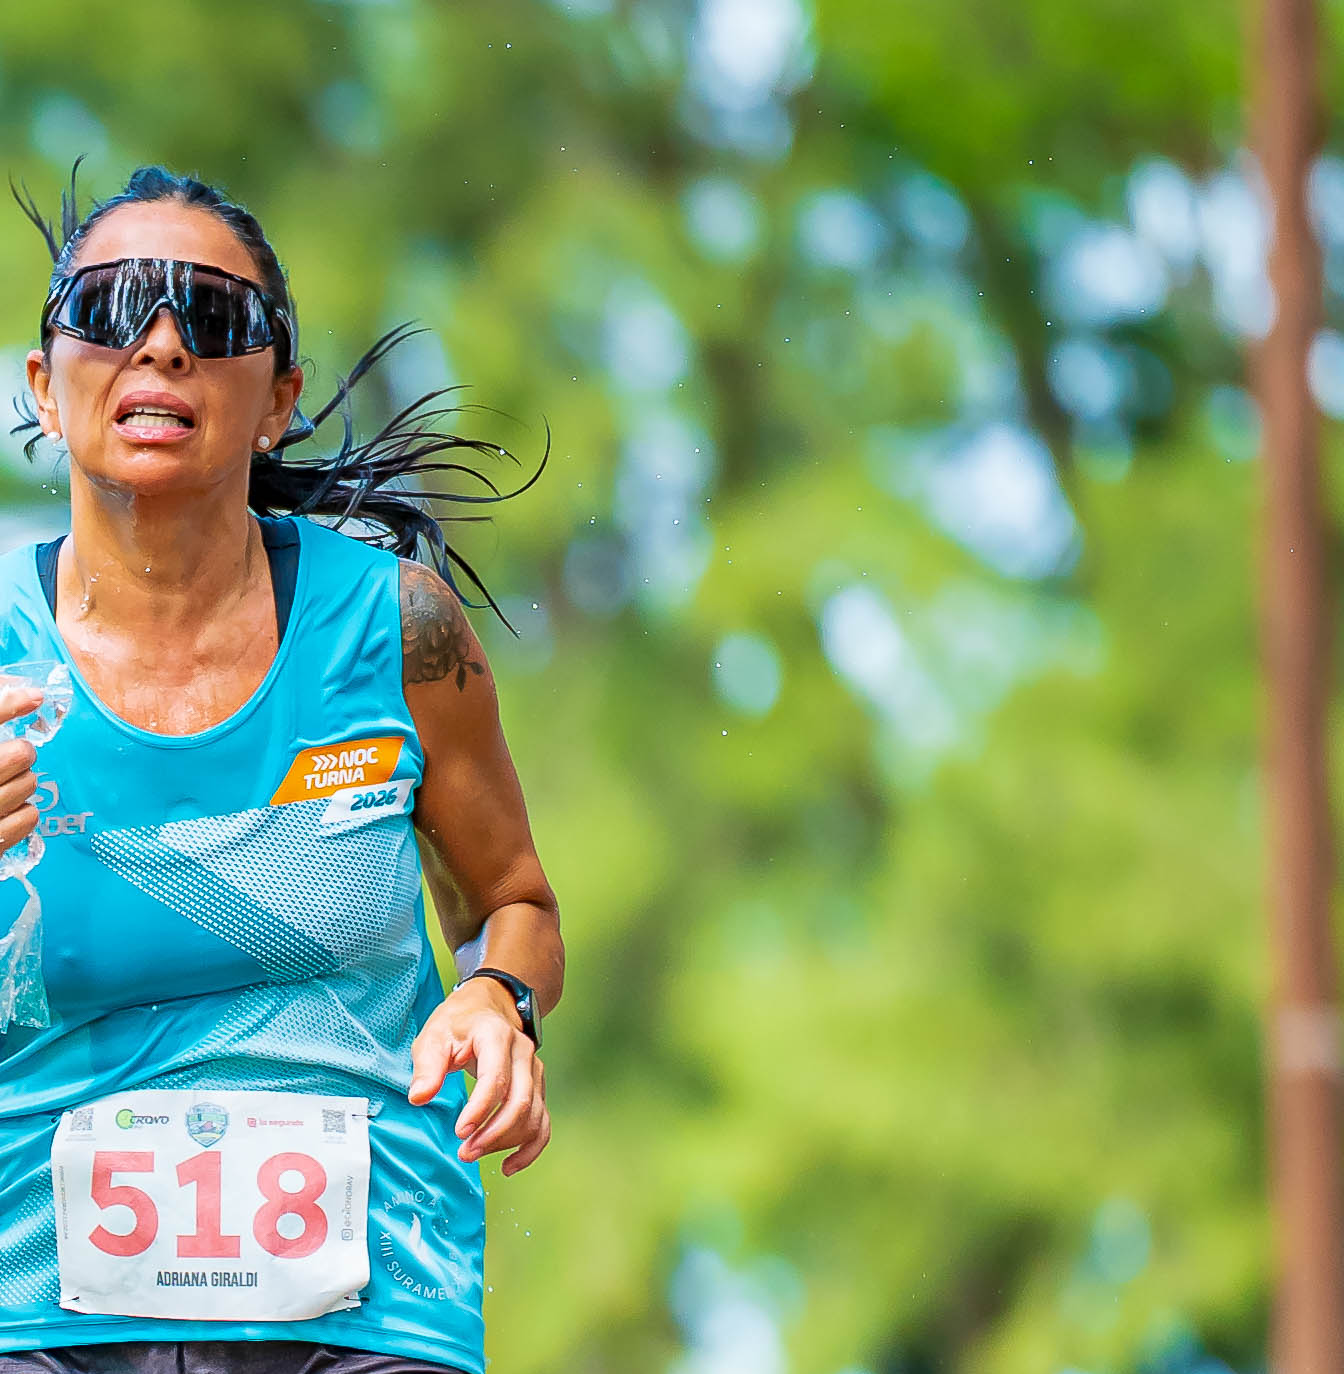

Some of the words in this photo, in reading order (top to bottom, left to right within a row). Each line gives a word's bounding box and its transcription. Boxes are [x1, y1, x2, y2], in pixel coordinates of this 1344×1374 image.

[338, 747, 379, 769] NOC
[304, 767, 365, 789] TURNA
[350, 787, 398, 811] 2026
[88, 1151, 328, 1259] 518
[156, 1271, 208, 1287] ADRIANA
[211, 1271, 258, 1287] GIRALDI
[387, 1261, 446, 1300] SURAME
